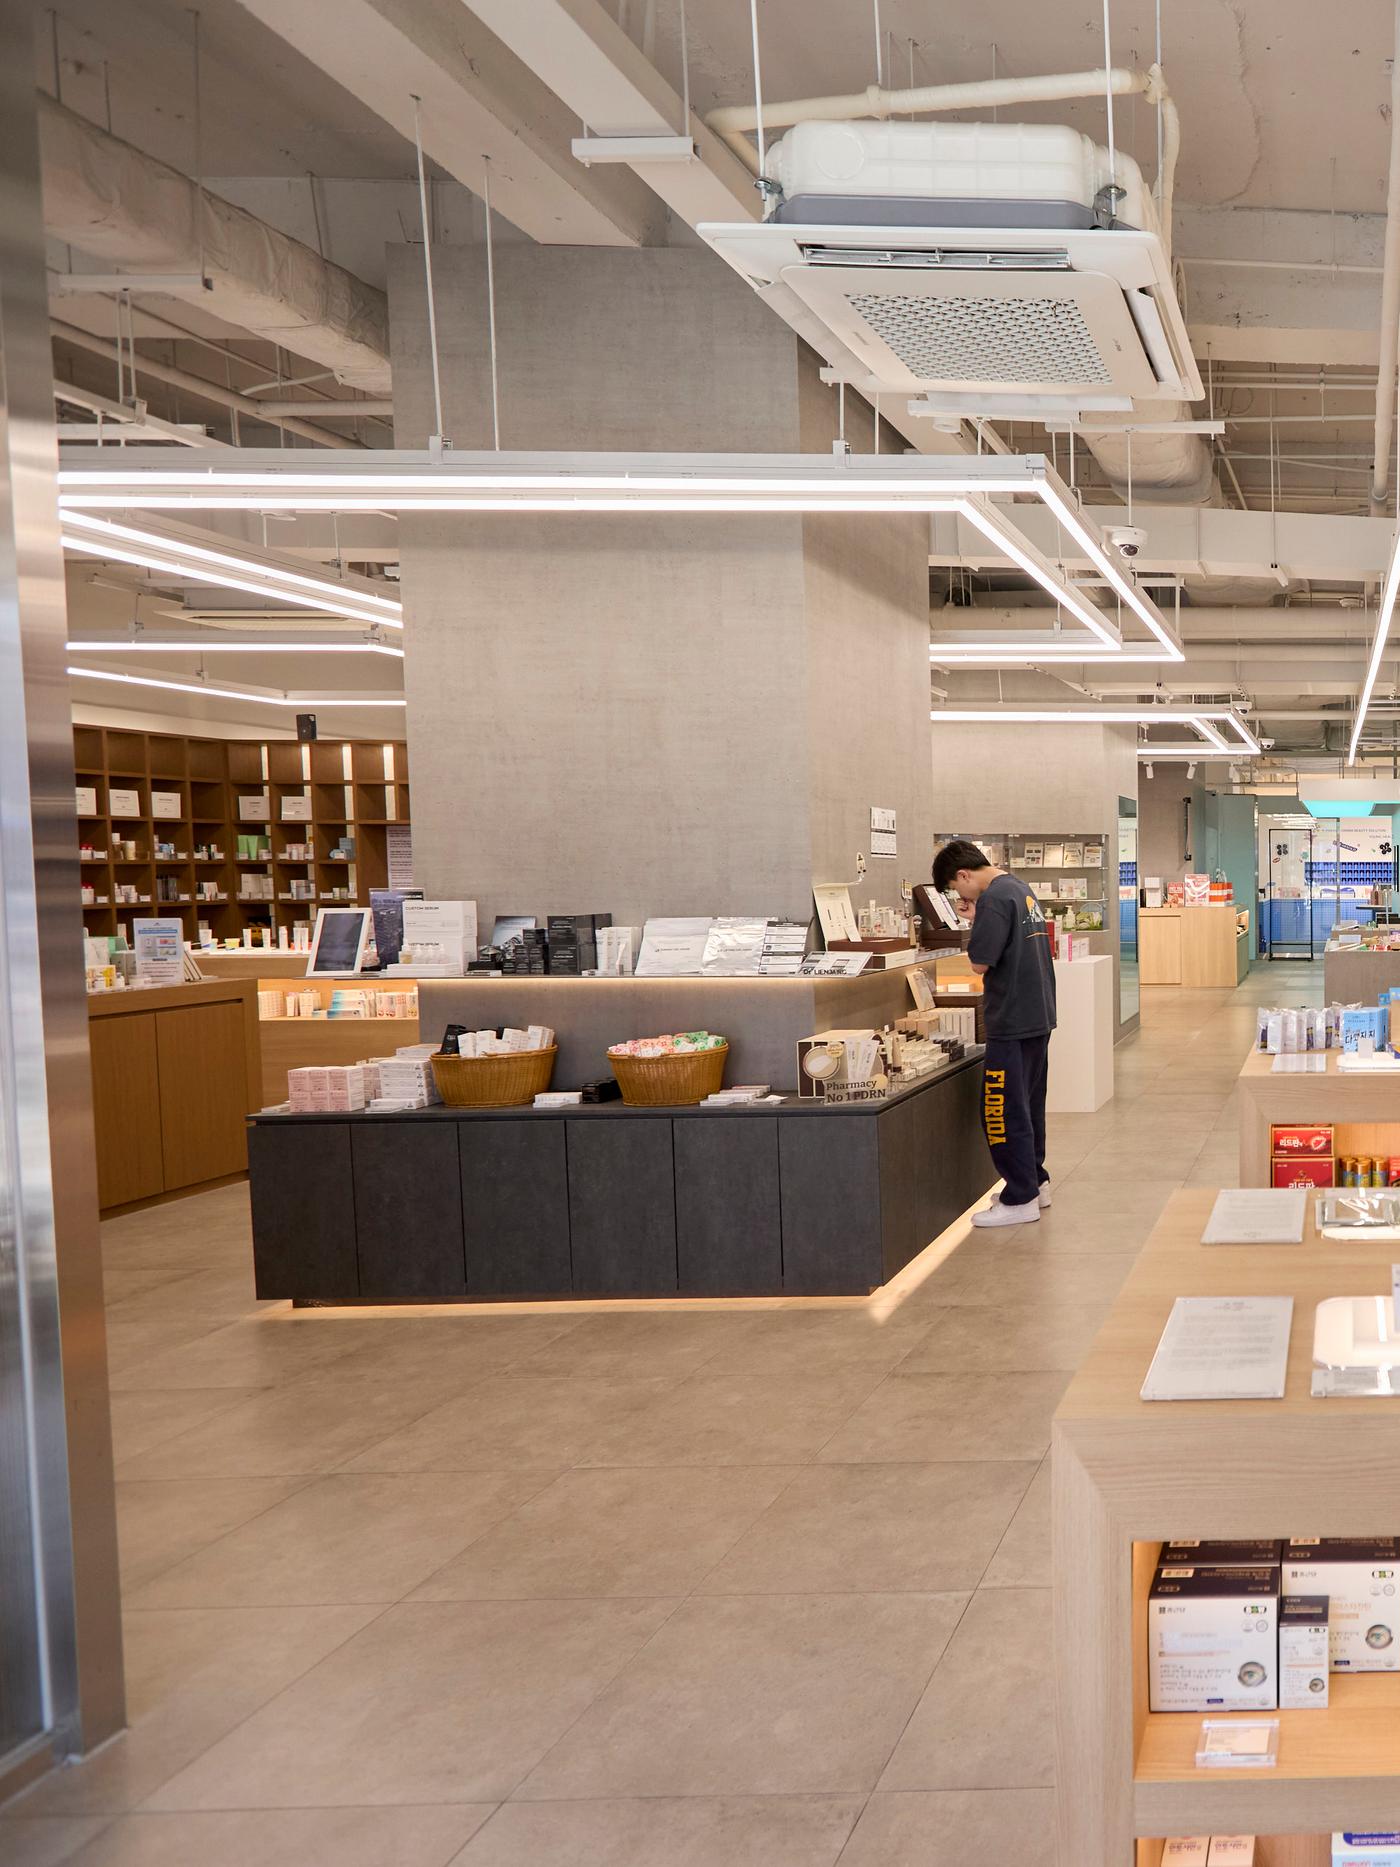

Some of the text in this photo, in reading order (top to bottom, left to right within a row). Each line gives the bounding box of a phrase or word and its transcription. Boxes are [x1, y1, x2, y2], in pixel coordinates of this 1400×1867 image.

[826, 1079, 877, 1091] Pharmacy
[827, 1093, 843, 1103] No
[853, 1089, 886, 1100] PDRN
[984, 1070, 1006, 1146] FLORIDA
